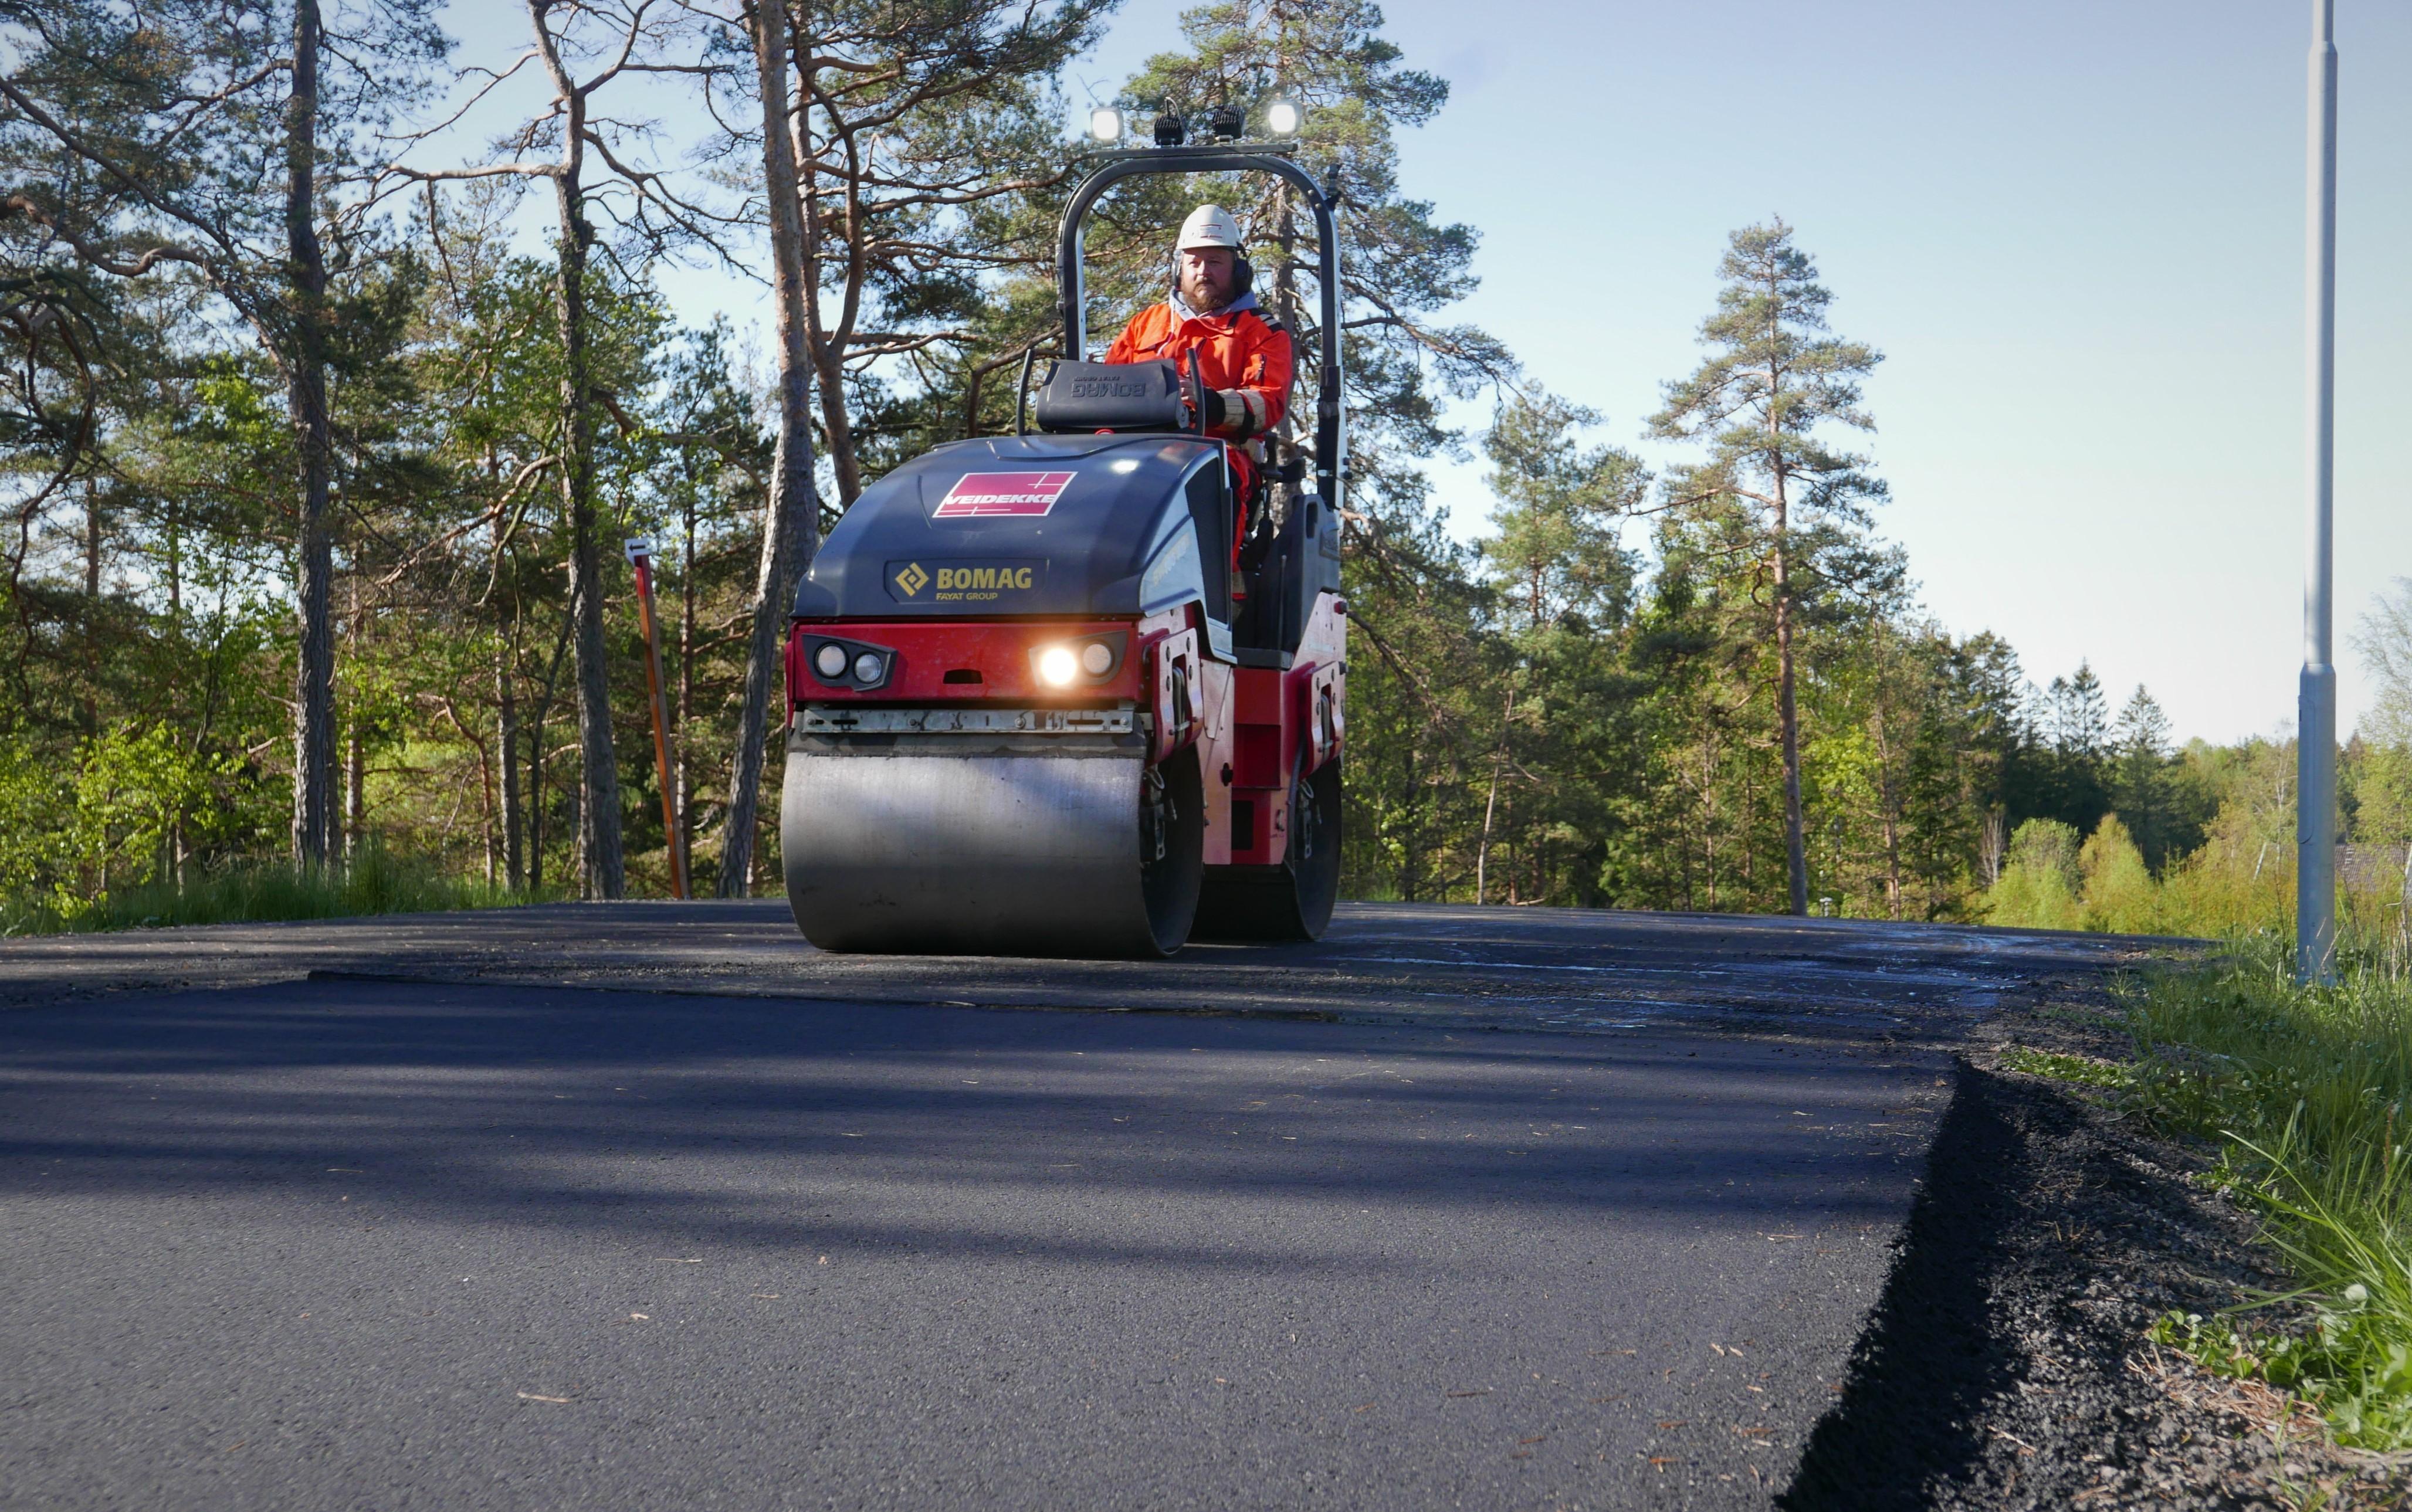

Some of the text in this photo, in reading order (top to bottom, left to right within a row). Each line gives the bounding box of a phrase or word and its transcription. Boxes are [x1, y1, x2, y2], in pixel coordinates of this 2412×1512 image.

[1071, 382, 1146, 398] BOMAG
[945, 494, 1057, 505] VEIDEKKE
[937, 568, 1032, 589] BOMAG
[936, 592, 963, 601] FAYAT
